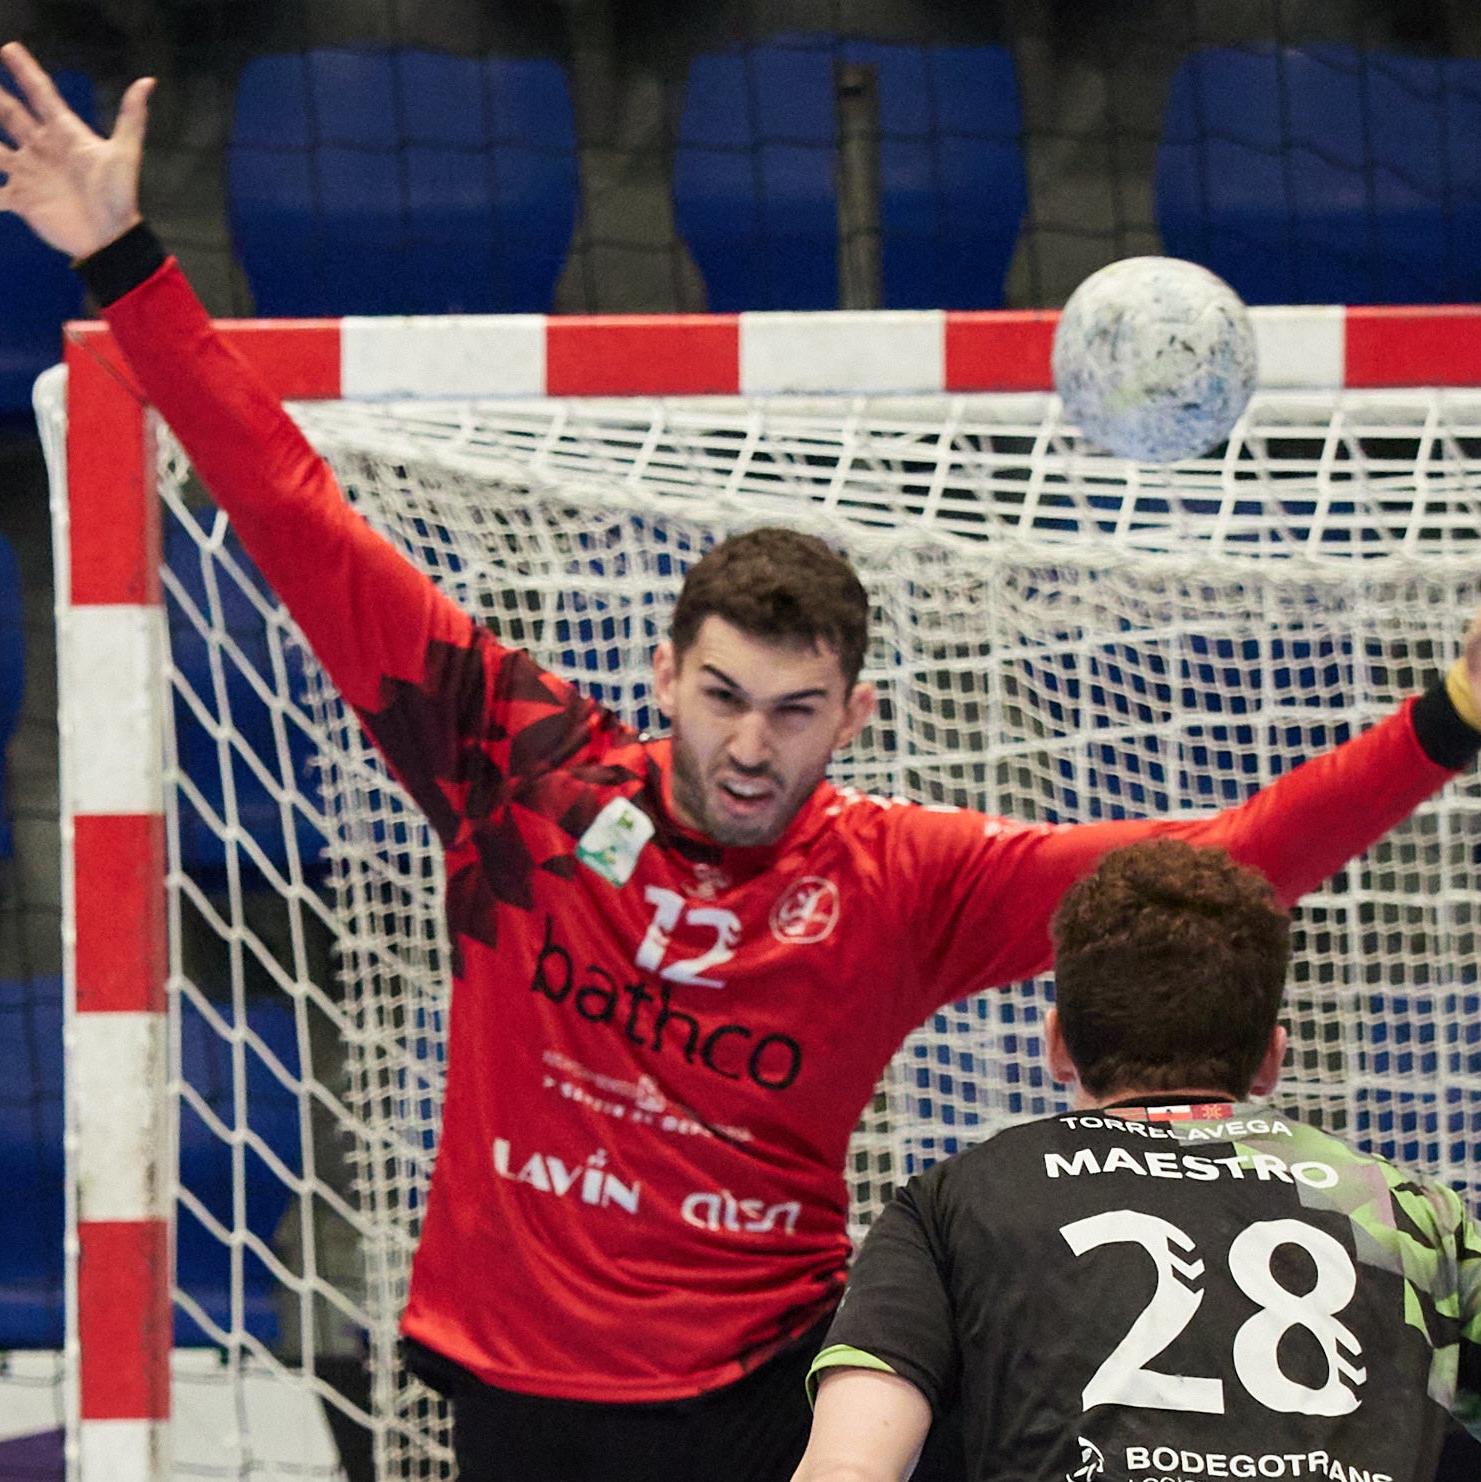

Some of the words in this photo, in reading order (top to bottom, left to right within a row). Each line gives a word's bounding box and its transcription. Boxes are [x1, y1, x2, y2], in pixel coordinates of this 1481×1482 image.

[635, 885, 743, 988] 12
[530, 914, 803, 1091] bathco
[1043, 1147, 1339, 1189] MAESTRO
[1059, 1116, 1294, 1142] TORRELAVEGA
[1059, 1209, 1368, 1418] 28
